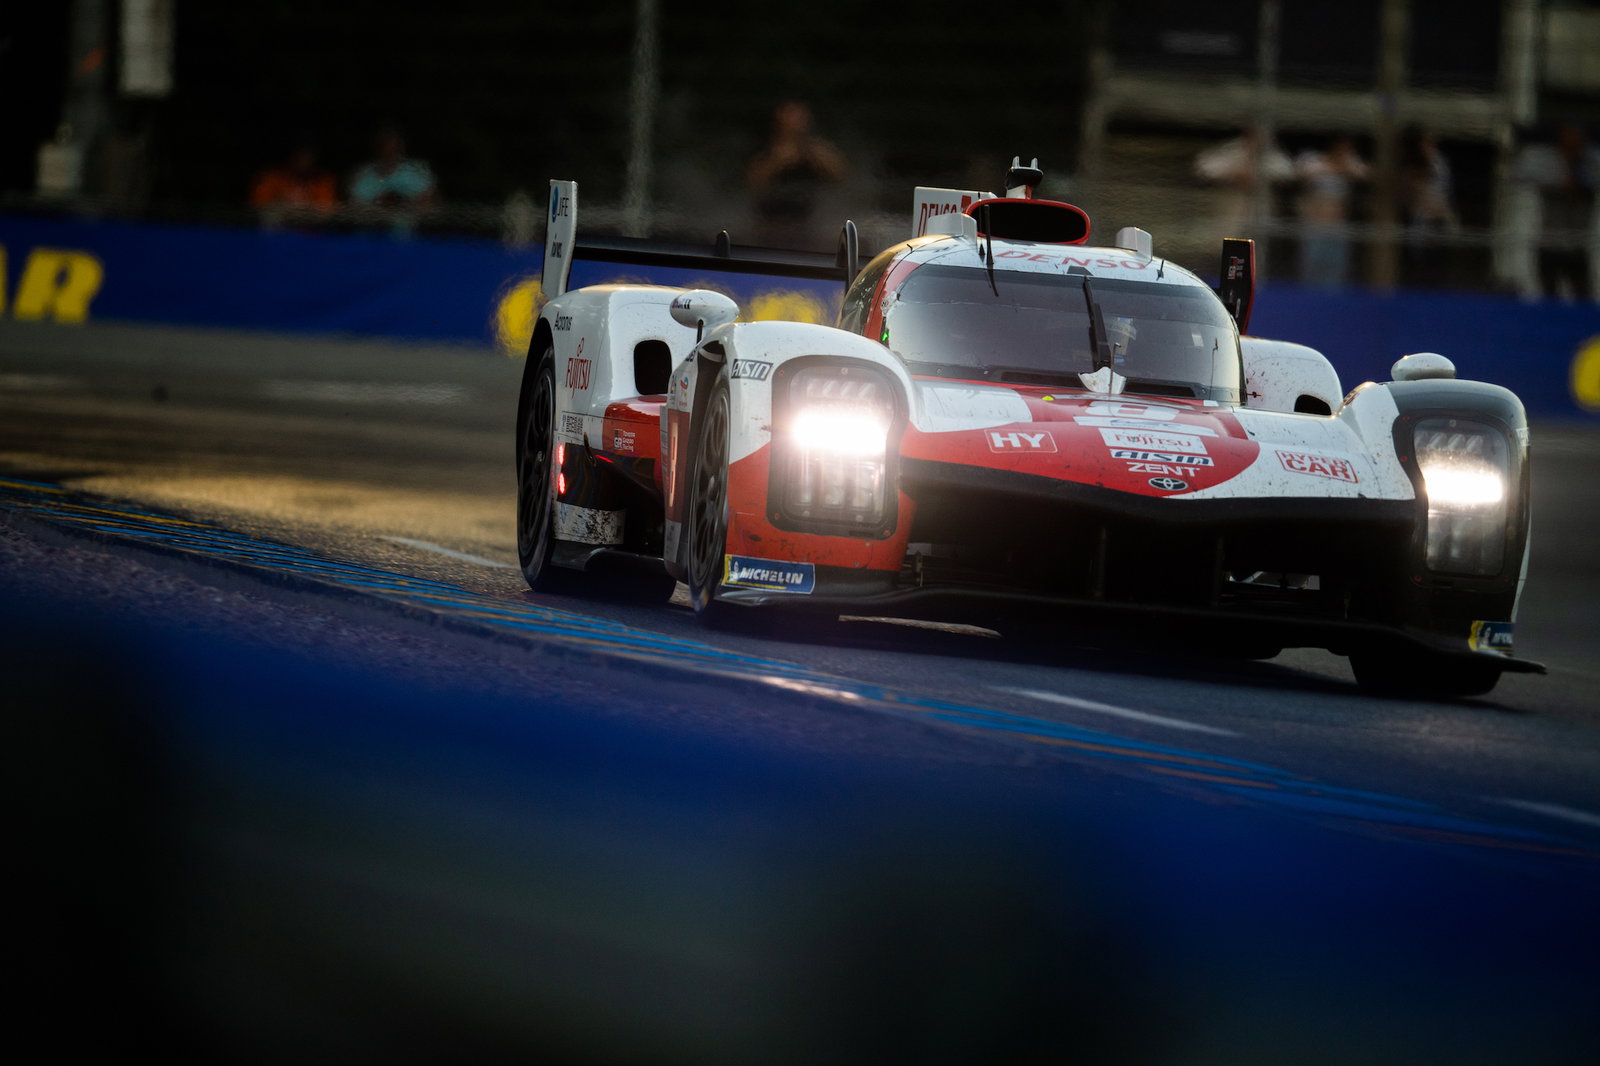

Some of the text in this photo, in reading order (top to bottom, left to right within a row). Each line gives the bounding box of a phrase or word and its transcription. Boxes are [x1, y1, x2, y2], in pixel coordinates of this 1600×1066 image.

[994, 250, 1149, 271] DENSO
[0, 244, 107, 323] R
[565, 356, 592, 398] FUJITSU
[732, 360, 771, 380] AISIN
[990, 432, 1045, 448] HY
[1115, 434, 1192, 451] FUJITSU
[1114, 450, 1209, 465] AISIN
[1281, 452, 1348, 468] HYPER
[1126, 462, 1200, 477] ZENT
[1286, 459, 1351, 479] CAR
[740, 567, 804, 584] MICHELIN
